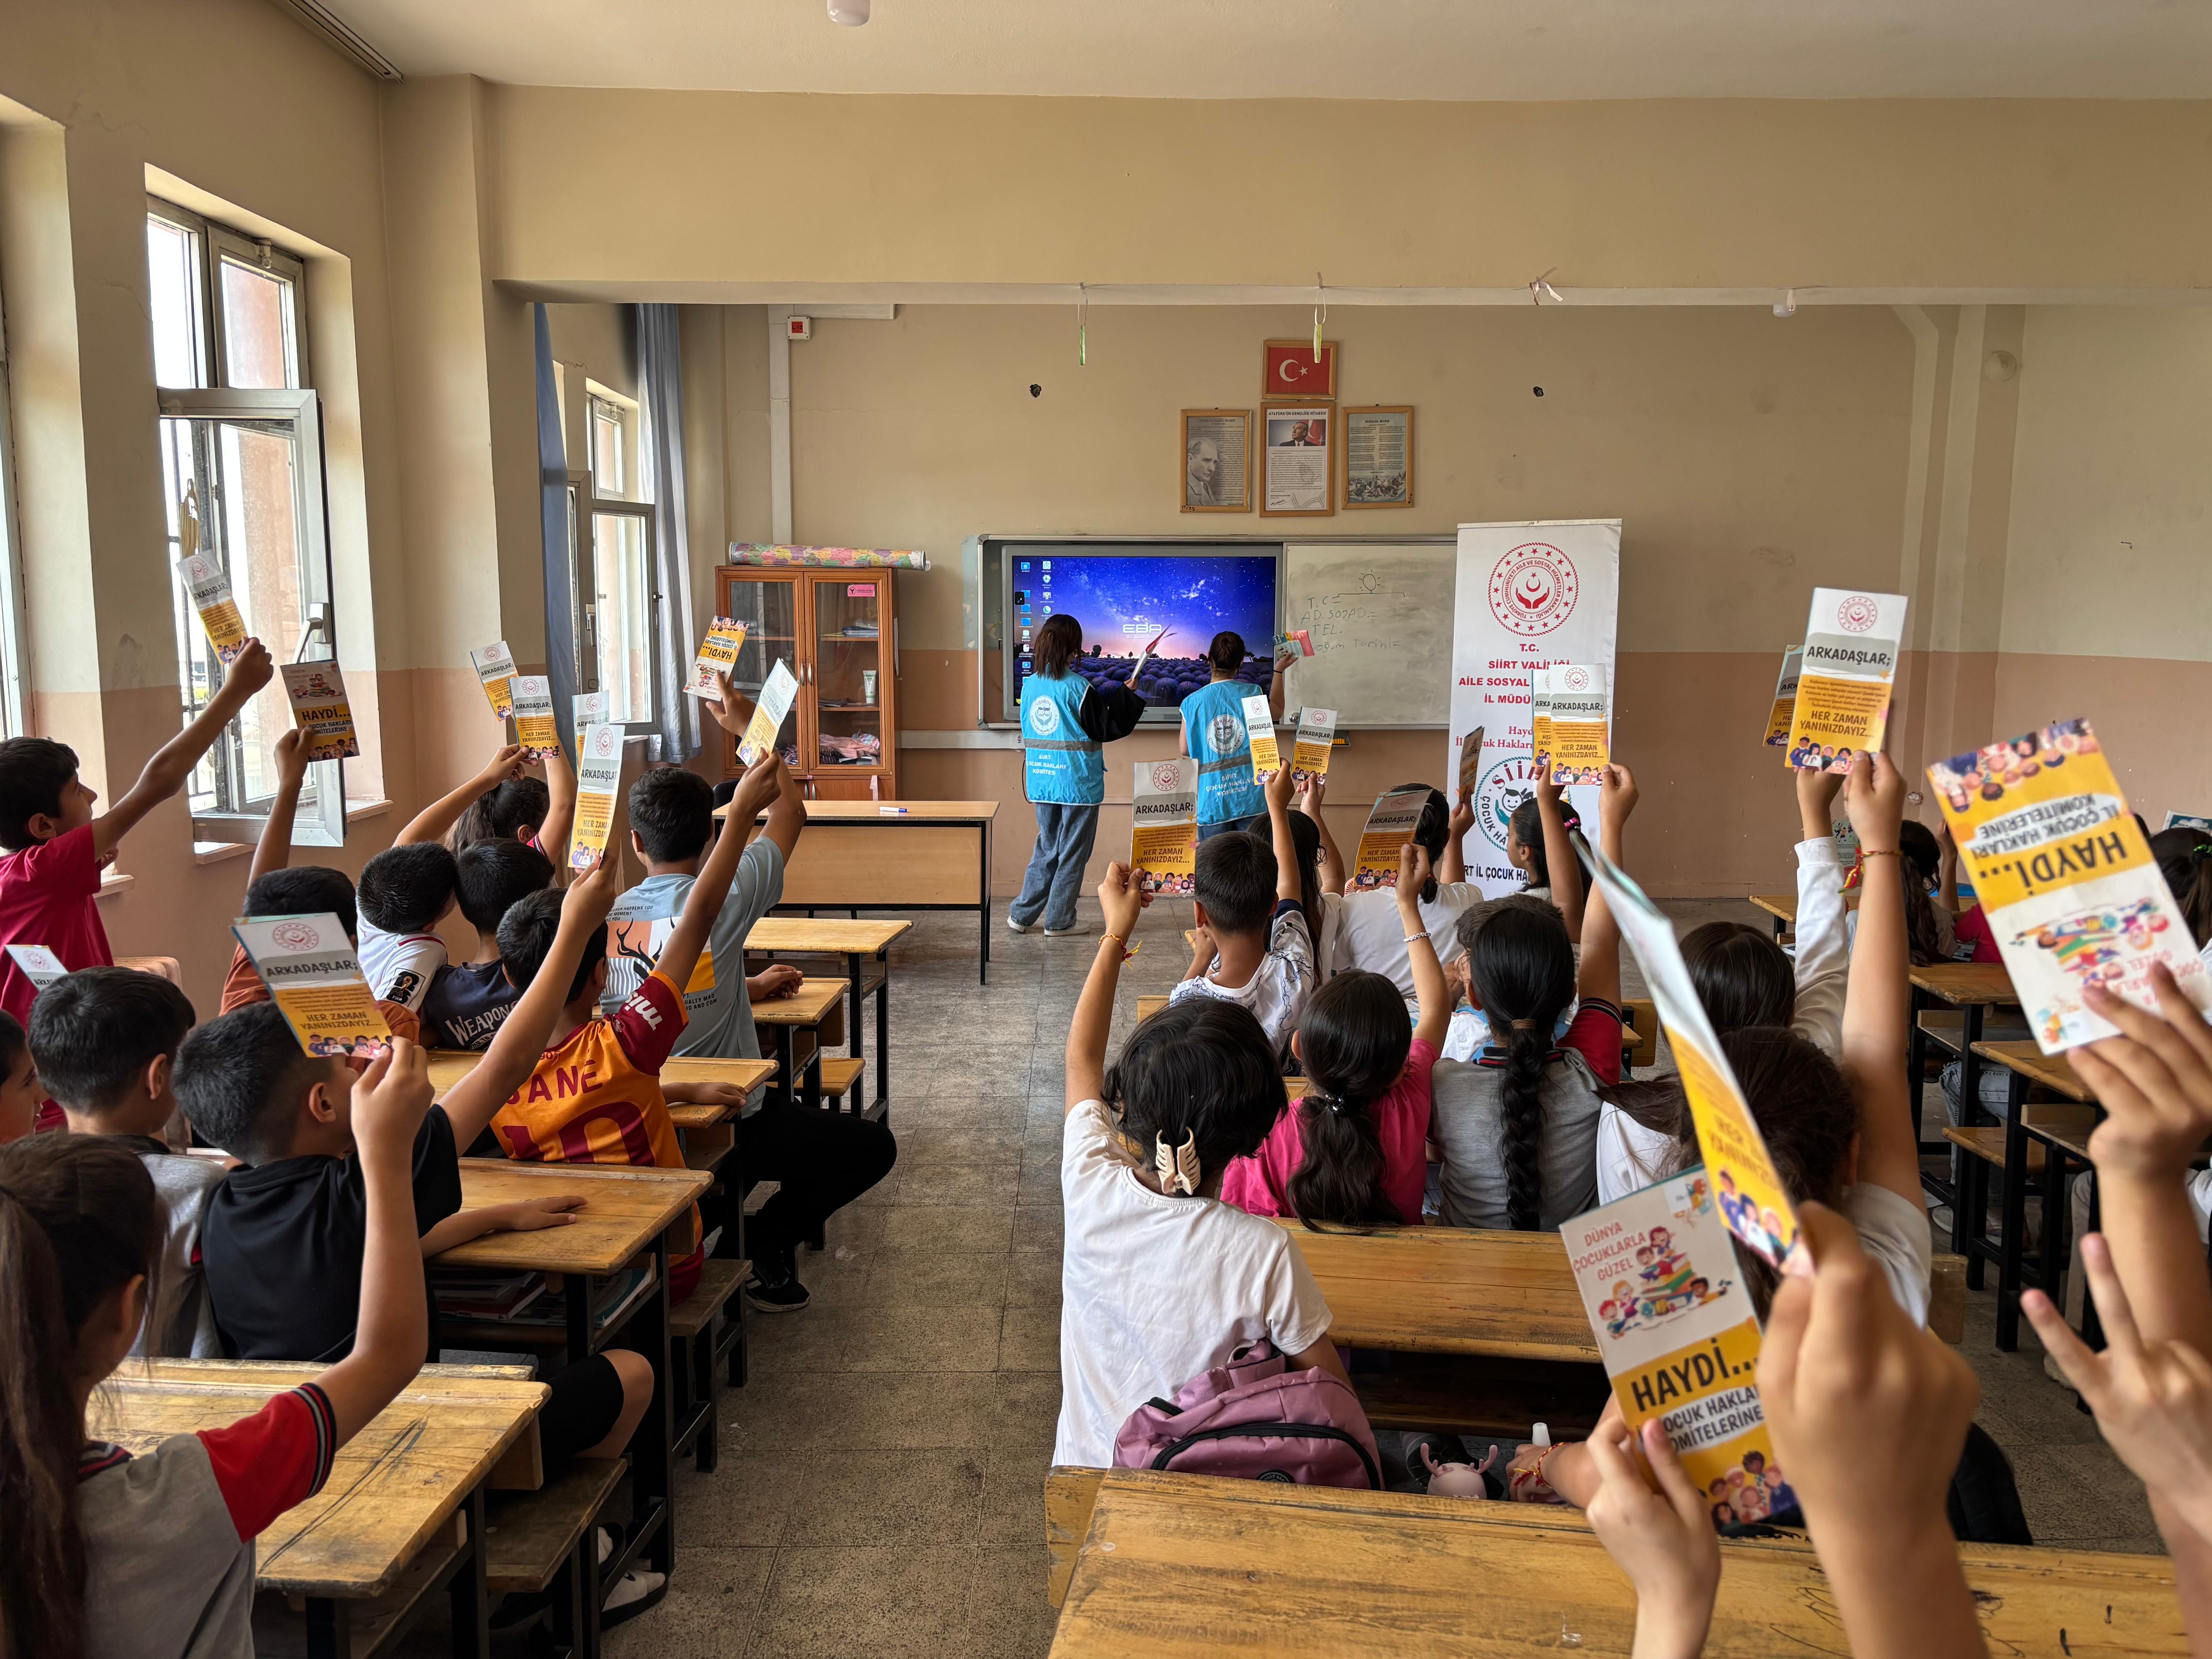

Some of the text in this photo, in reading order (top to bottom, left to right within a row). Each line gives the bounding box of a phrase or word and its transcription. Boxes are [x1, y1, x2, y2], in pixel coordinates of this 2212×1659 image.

[1516, 562, 1526, 571] AİLE
[1534, 560, 1552, 571] SOSYAL
[1504, 569, 1516, 604] CUMHURİYETİ
[1551, 569, 1561, 597] HİZMETLER
[1509, 604, 1526, 619] TÜRKİYE
[1536, 597, 1559, 619] BAKANLIĞI
[1123, 624, 1162, 634] EBA
[1519, 644, 1539, 652] T.C.
[1488, 659, 1518, 669] SİİRT
[1807, 646, 1891, 667] ARKADAŞLAR;
[1459, 676, 1530, 686] AİLE SOSYAL
[1484, 693, 1494, 703] İL
[302, 706, 350, 721] HAYDİ...
[1552, 702, 1603, 712] ARKADAŞLAR;
[1811, 710, 1868, 725] HER ZAMAN
[1298, 730, 1332, 739] ARKADAŞLAR;
[1135, 802, 1193, 814] ARKADAŞLAR;
[1369, 815, 1417, 824] ARKADAŞLAR;
[1136, 856, 1189, 864] YANINIZDAYIZ...
[1980, 831, 2127, 896] HAYDİ...
[1476, 863, 1483, 877] İL
[1485, 867, 1514, 881] ÇOCUK
[267, 960, 359, 978] ARKADAŞLAR;
[306, 1011, 367, 1022] HER ZAMAN
[502, 1101, 656, 1166] 10
[1584, 1221, 1623, 1247] DÜNYA
[1573, 1231, 1646, 1275] ÇOCUKLARLA
[1597, 1257, 1634, 1281] GÜZEL
